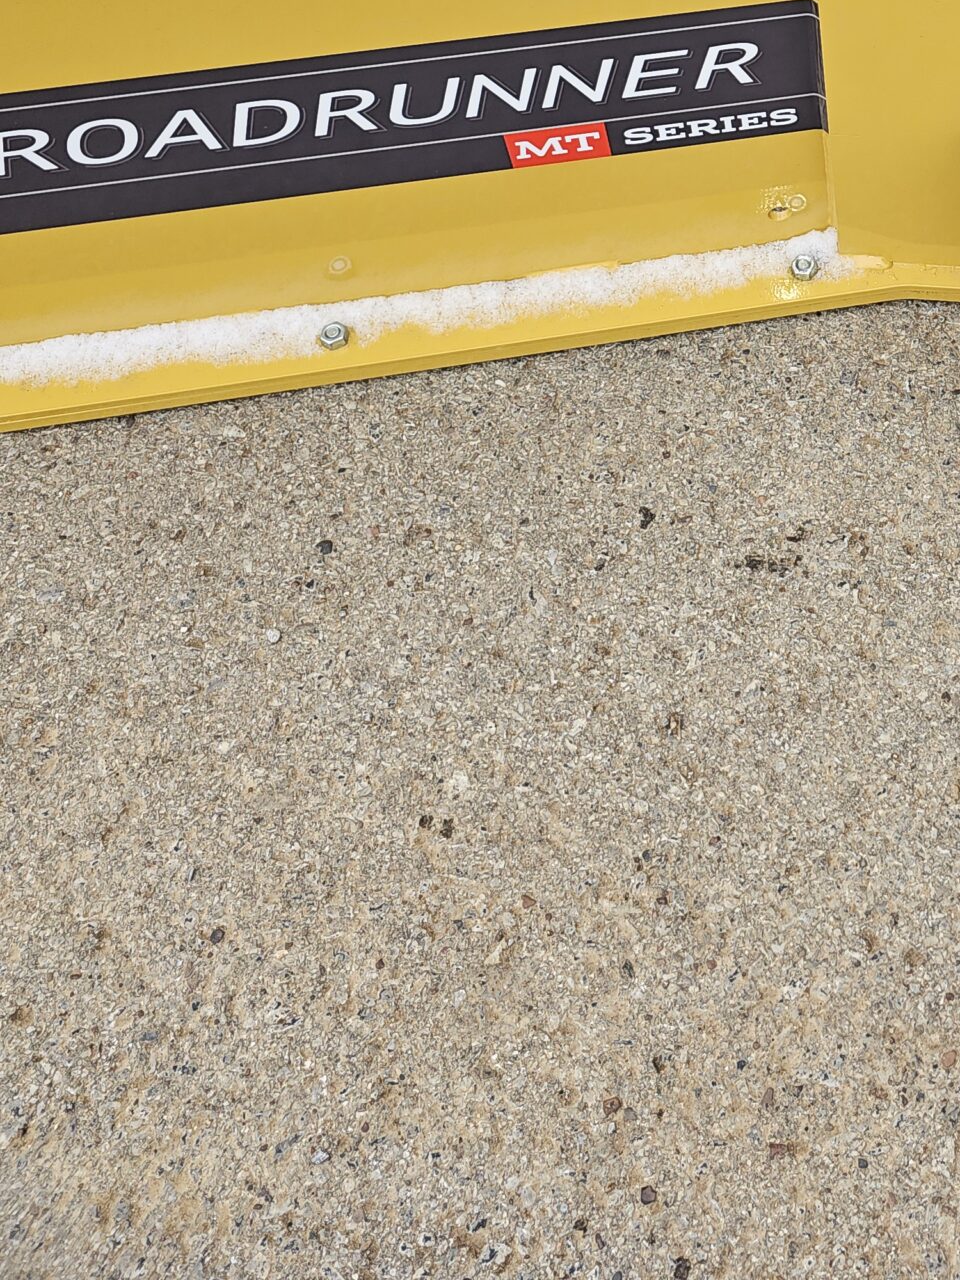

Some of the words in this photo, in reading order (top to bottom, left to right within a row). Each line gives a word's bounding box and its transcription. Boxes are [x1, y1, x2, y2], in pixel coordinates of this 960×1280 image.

[0, 41, 761, 176] ROADRUNNER
[514, 131, 601, 160] MT
[623, 107, 799, 146] SERIES
